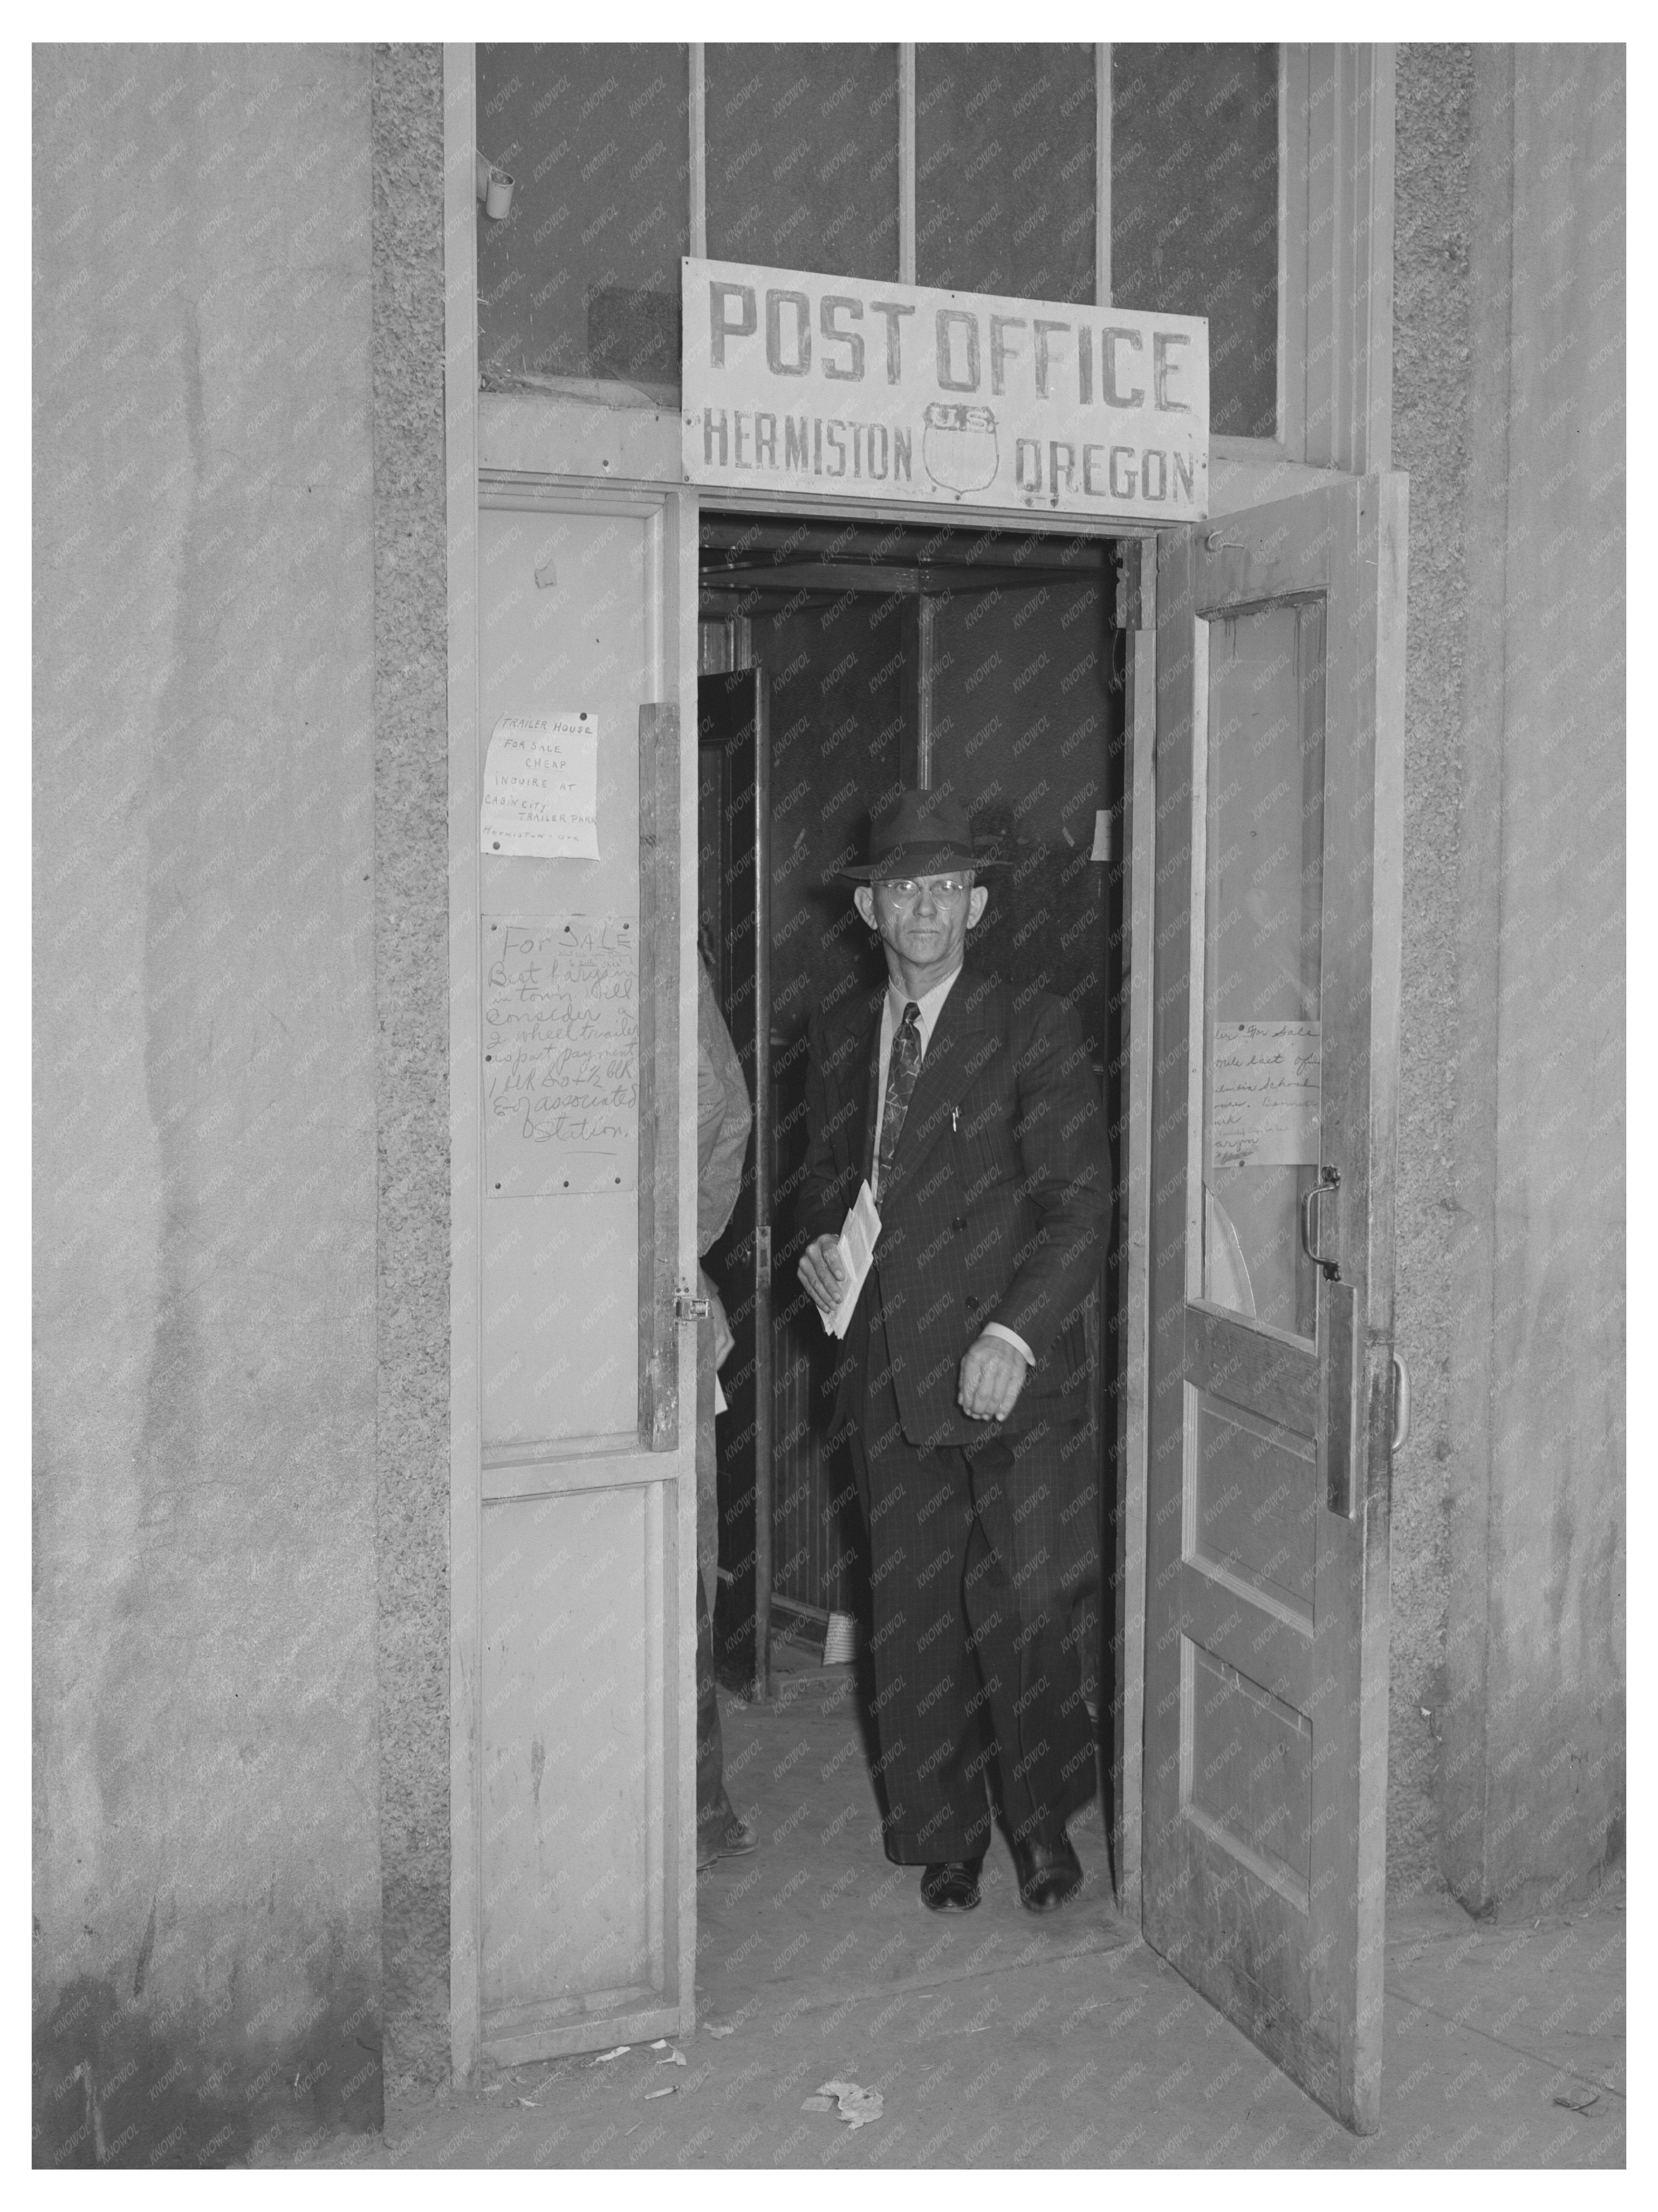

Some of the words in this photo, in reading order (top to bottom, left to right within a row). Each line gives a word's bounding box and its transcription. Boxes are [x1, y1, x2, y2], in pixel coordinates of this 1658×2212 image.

[709, 281, 915, 385] POST
[935, 309, 1192, 414] OFFICE
[703, 408, 912, 482] HERMISTON
[1015, 438, 1194, 505] OREGON
[502, 718, 547, 730] TRAILER
[553, 722, 593, 734] HOUSE
[504, 739, 525, 749] FOR
[531, 742, 562, 754] SALE
[525, 758, 566, 769] CHEAP
[560, 783, 576, 791] AT
[485, 794, 518, 806] CABIN
[519, 812, 566, 823] TRAILER
[570, 814, 597, 825] PARK
[503, 926, 551, 962] For
[489, 961, 542, 987] Best
[617, 1008, 634, 1019] a
[517, 1023, 578, 1041] wheel
[579, 1017, 639, 1040] trailer
[1216, 1030, 1237, 1041] ler
